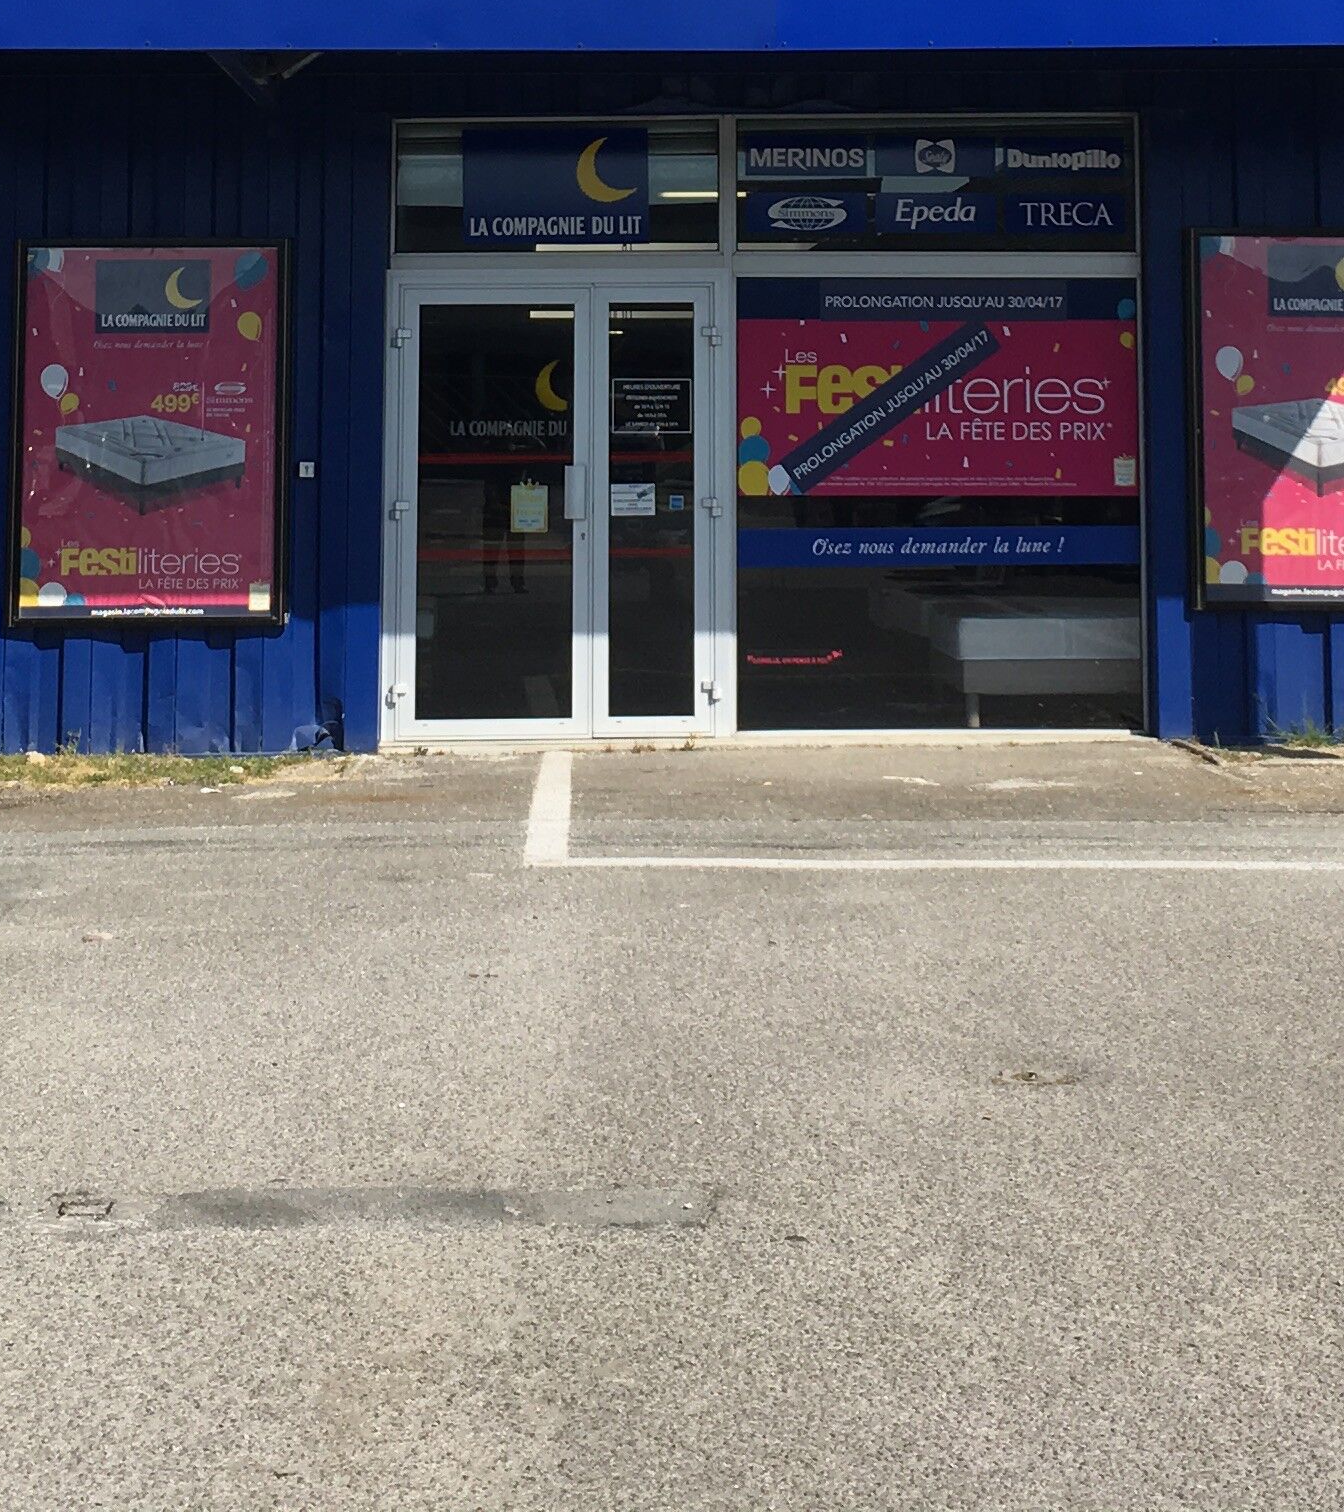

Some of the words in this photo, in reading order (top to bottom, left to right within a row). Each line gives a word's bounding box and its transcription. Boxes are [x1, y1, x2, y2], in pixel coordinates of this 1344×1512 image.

[750, 147, 865, 171] MERINOS
[1007, 148, 1121, 171] Dunlopillo
[777, 208, 836, 218] Simmons
[895, 198, 976, 230] Epeda
[1019, 202, 1113, 226] TRECA
[470, 217, 489, 236] LA
[492, 216, 586, 236] COMPAGNIE
[592, 216, 614, 235] DU
[619, 215, 642, 235] LIT
[824, 296, 934, 309] PROLONGATION
[936, 295, 1005, 309] JUSQU'AU
[1008, 295, 1063, 309] 30/04/17
[1273, 298, 1286, 311] LA
[1287, 298, 1344, 312] COMPAGNIE
[101, 314, 114, 327] LA
[115, 314, 173, 327] COMPAGNIE
[175, 314, 190, 327] DU
[191, 314, 207, 327] LIT
[785, 349, 818, 364] Les
[151, 392, 200, 414] 499€
[792, 405, 886, 481] PROLONGATION
[885, 365, 944, 416] JUSQU'AU
[940, 329, 992, 373] 30/04/17
[450, 420, 466, 436] LA
[469, 420, 545, 437] COMPAGNIE
[548, 420, 567, 436] DU
[925, 422, 953, 440] LA
[960, 418, 1005, 440] FÊTE
[1012, 422, 1052, 441] DES
[858, 542, 895, 555] nous
[900, 537, 985, 555] demander
[992, 536, 1012, 555] la
[1016, 536, 1052, 554] lune
[1056, 537, 1065, 554] !
[60, 547, 240, 576] Festiliteries
[1316, 560, 1334, 571] LA
[138, 579, 154, 589] LA
[157, 576, 183, 589] FÊTE
[186, 579, 209, 589] DES
